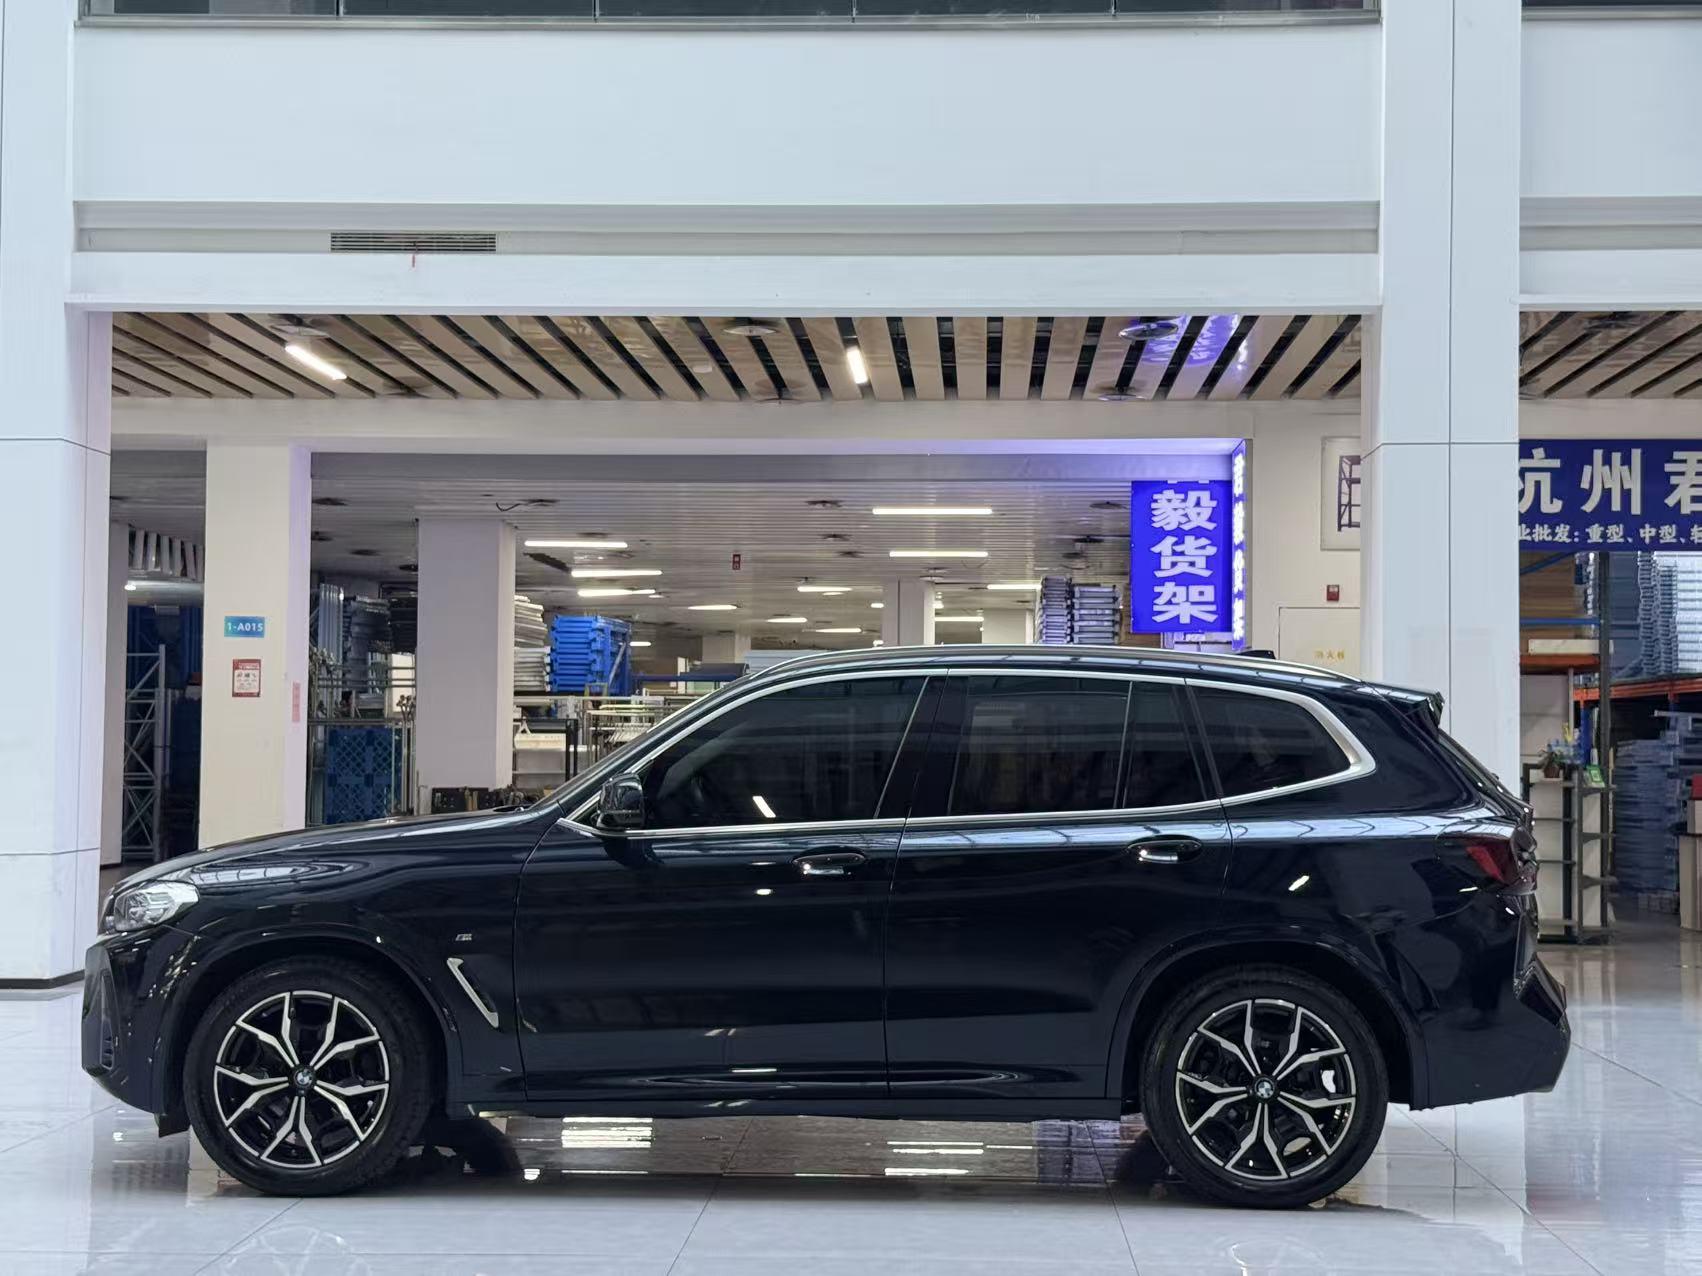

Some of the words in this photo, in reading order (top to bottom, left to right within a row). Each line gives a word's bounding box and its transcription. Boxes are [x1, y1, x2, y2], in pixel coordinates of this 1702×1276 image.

[1150, 480, 1219, 624] 毅货架
[227, 622, 264, 632] 1-A015
